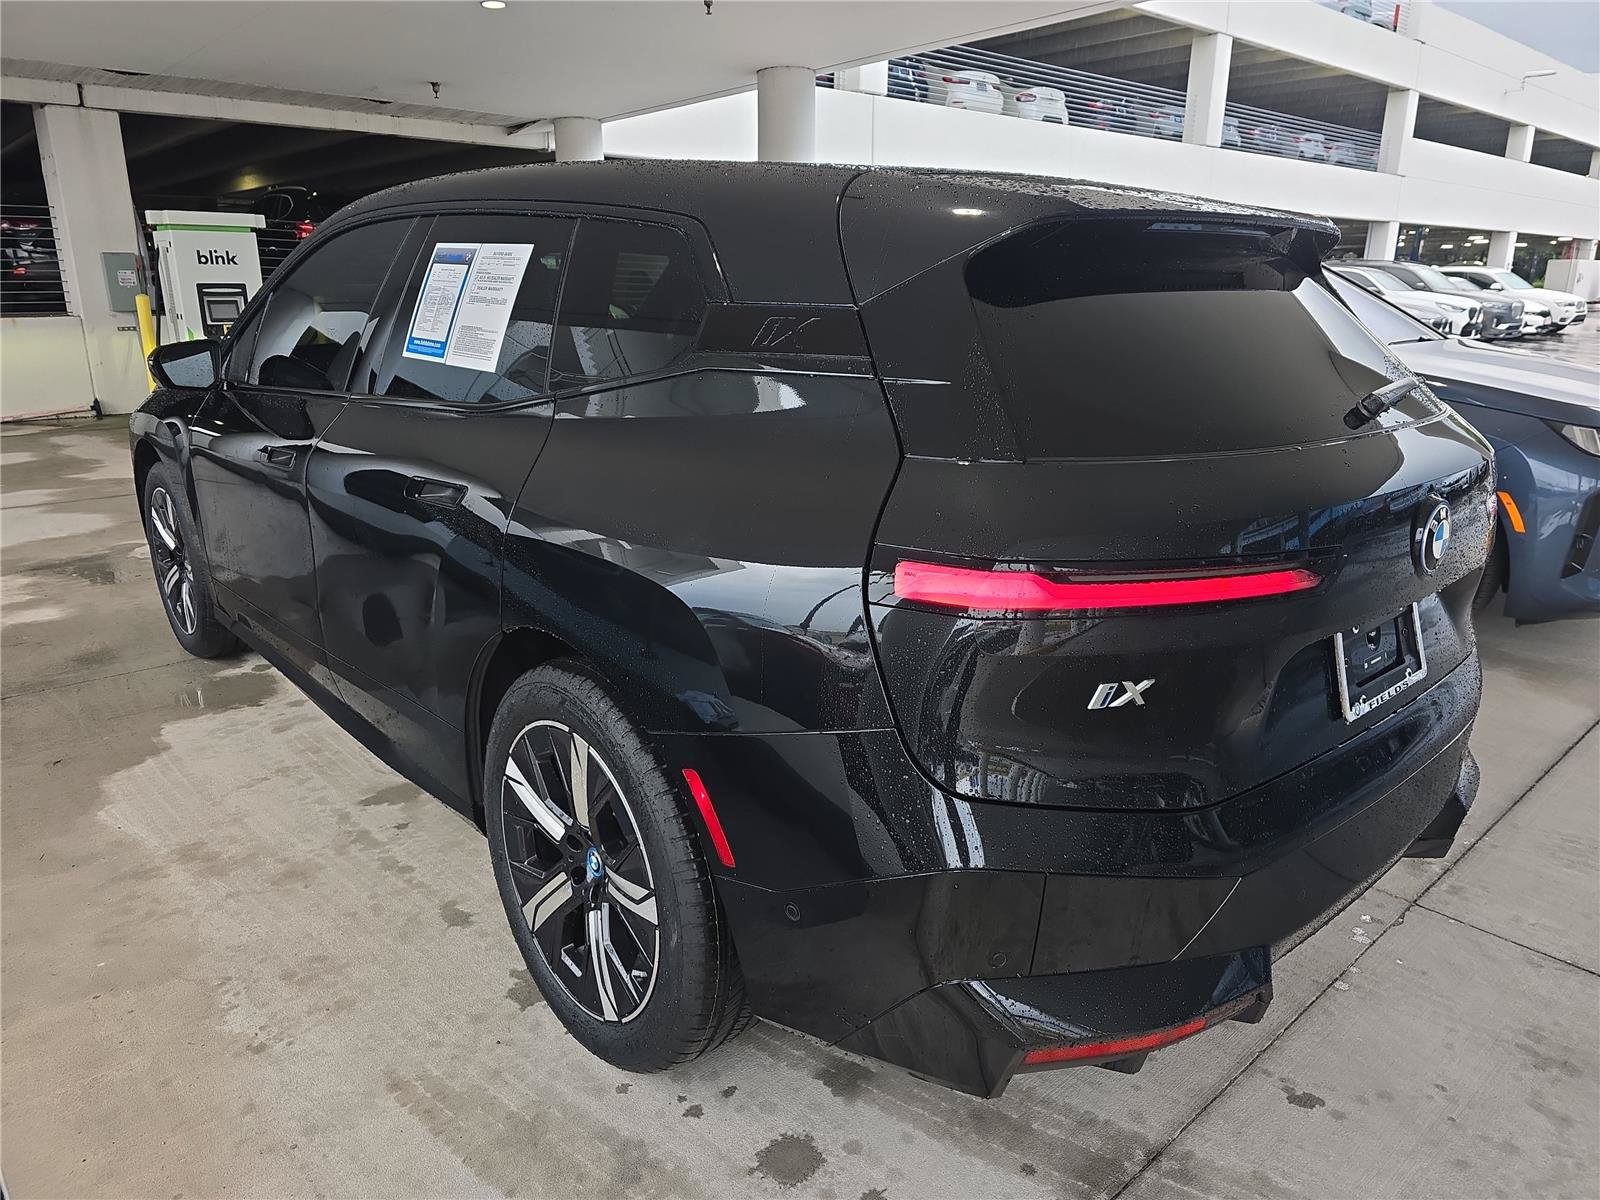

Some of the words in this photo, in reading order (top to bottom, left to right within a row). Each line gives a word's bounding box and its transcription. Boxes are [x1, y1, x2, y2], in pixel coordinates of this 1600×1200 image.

[196, 249, 239, 265] blink
[1087, 679, 1156, 710] iX
[1369, 680, 1409, 710] FIELDS
